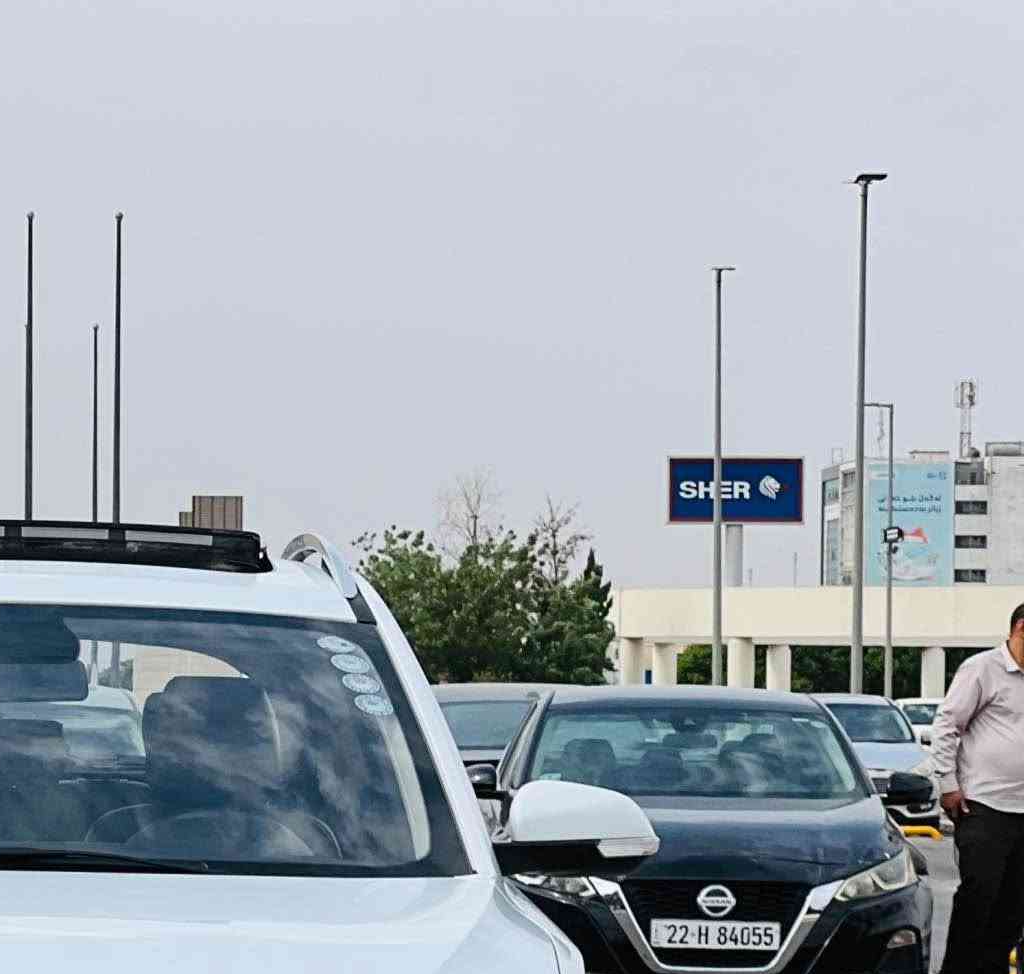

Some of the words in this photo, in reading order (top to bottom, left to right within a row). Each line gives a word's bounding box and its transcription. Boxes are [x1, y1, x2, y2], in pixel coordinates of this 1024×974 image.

[679, 480, 751, 500] SHER
[667, 924, 689, 944] 22
[698, 925, 709, 945] H
[716, 926, 774, 947] 84055
